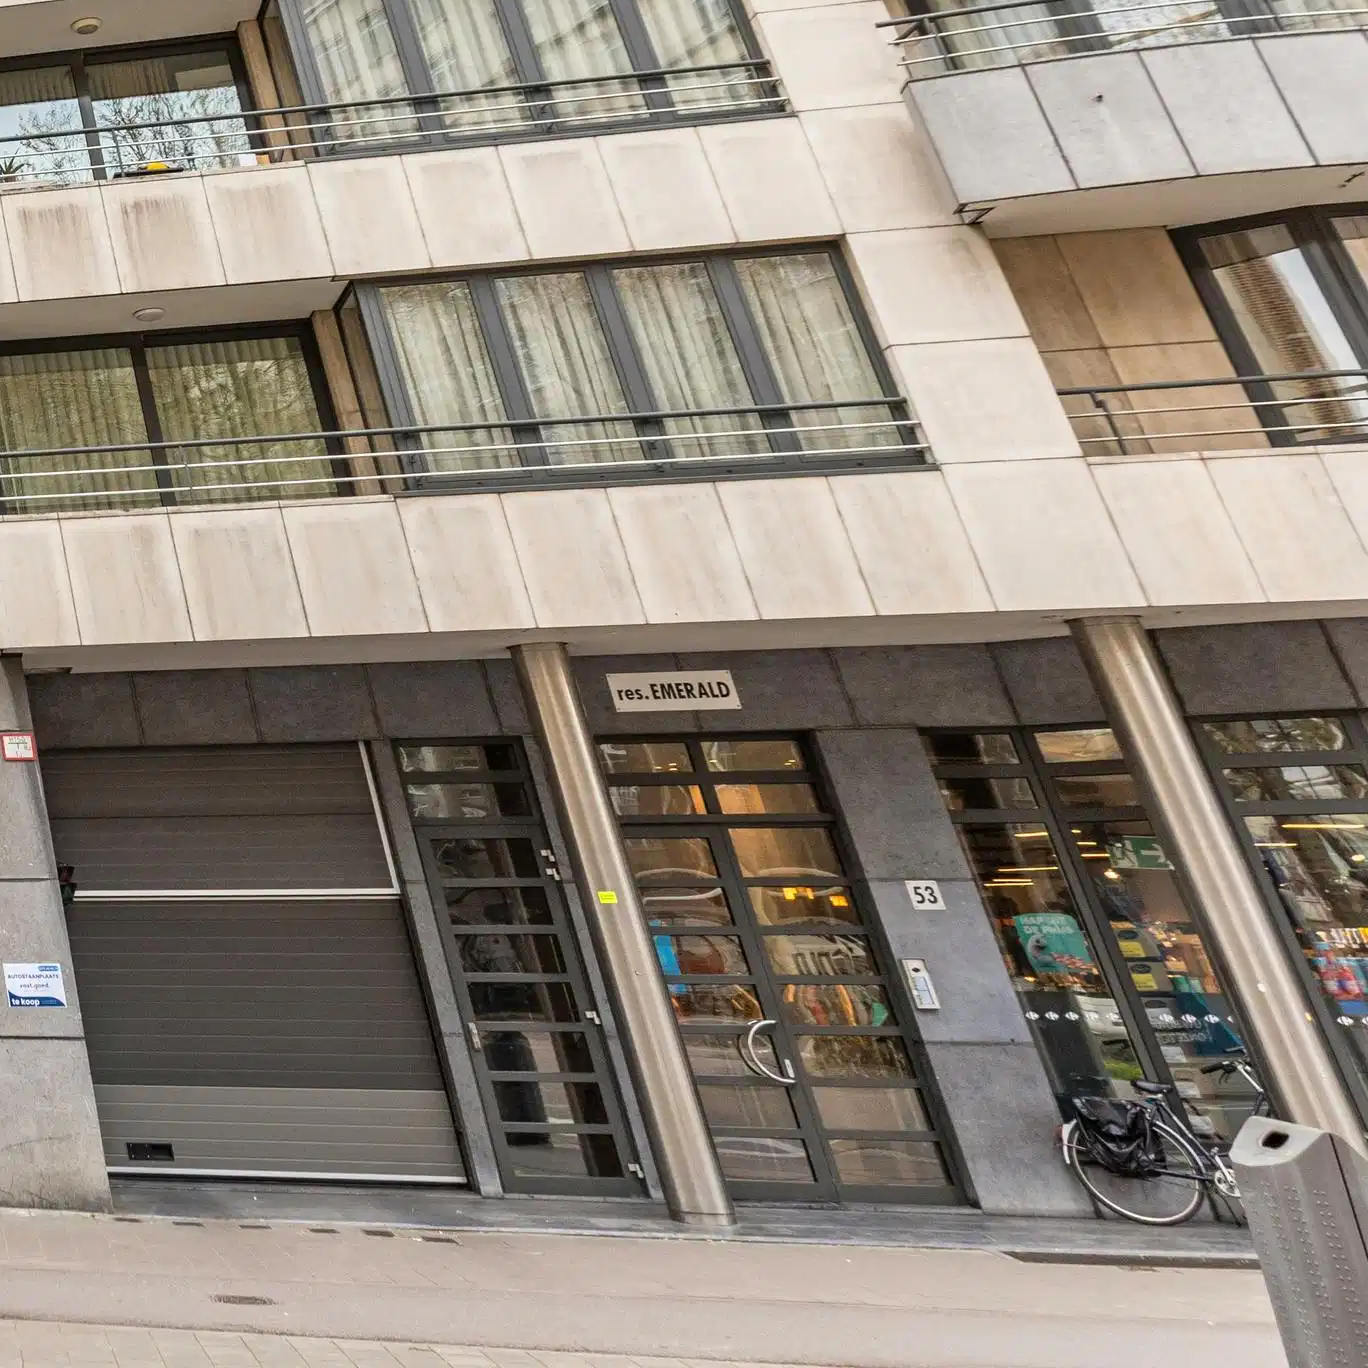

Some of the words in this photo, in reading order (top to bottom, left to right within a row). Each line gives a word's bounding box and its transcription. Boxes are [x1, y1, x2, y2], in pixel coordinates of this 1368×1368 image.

[616, 688, 650, 701] res.
[649, 681, 731, 700] EMERALD
[913, 886, 938, 904] 53
[21, 997, 40, 1007] koop
